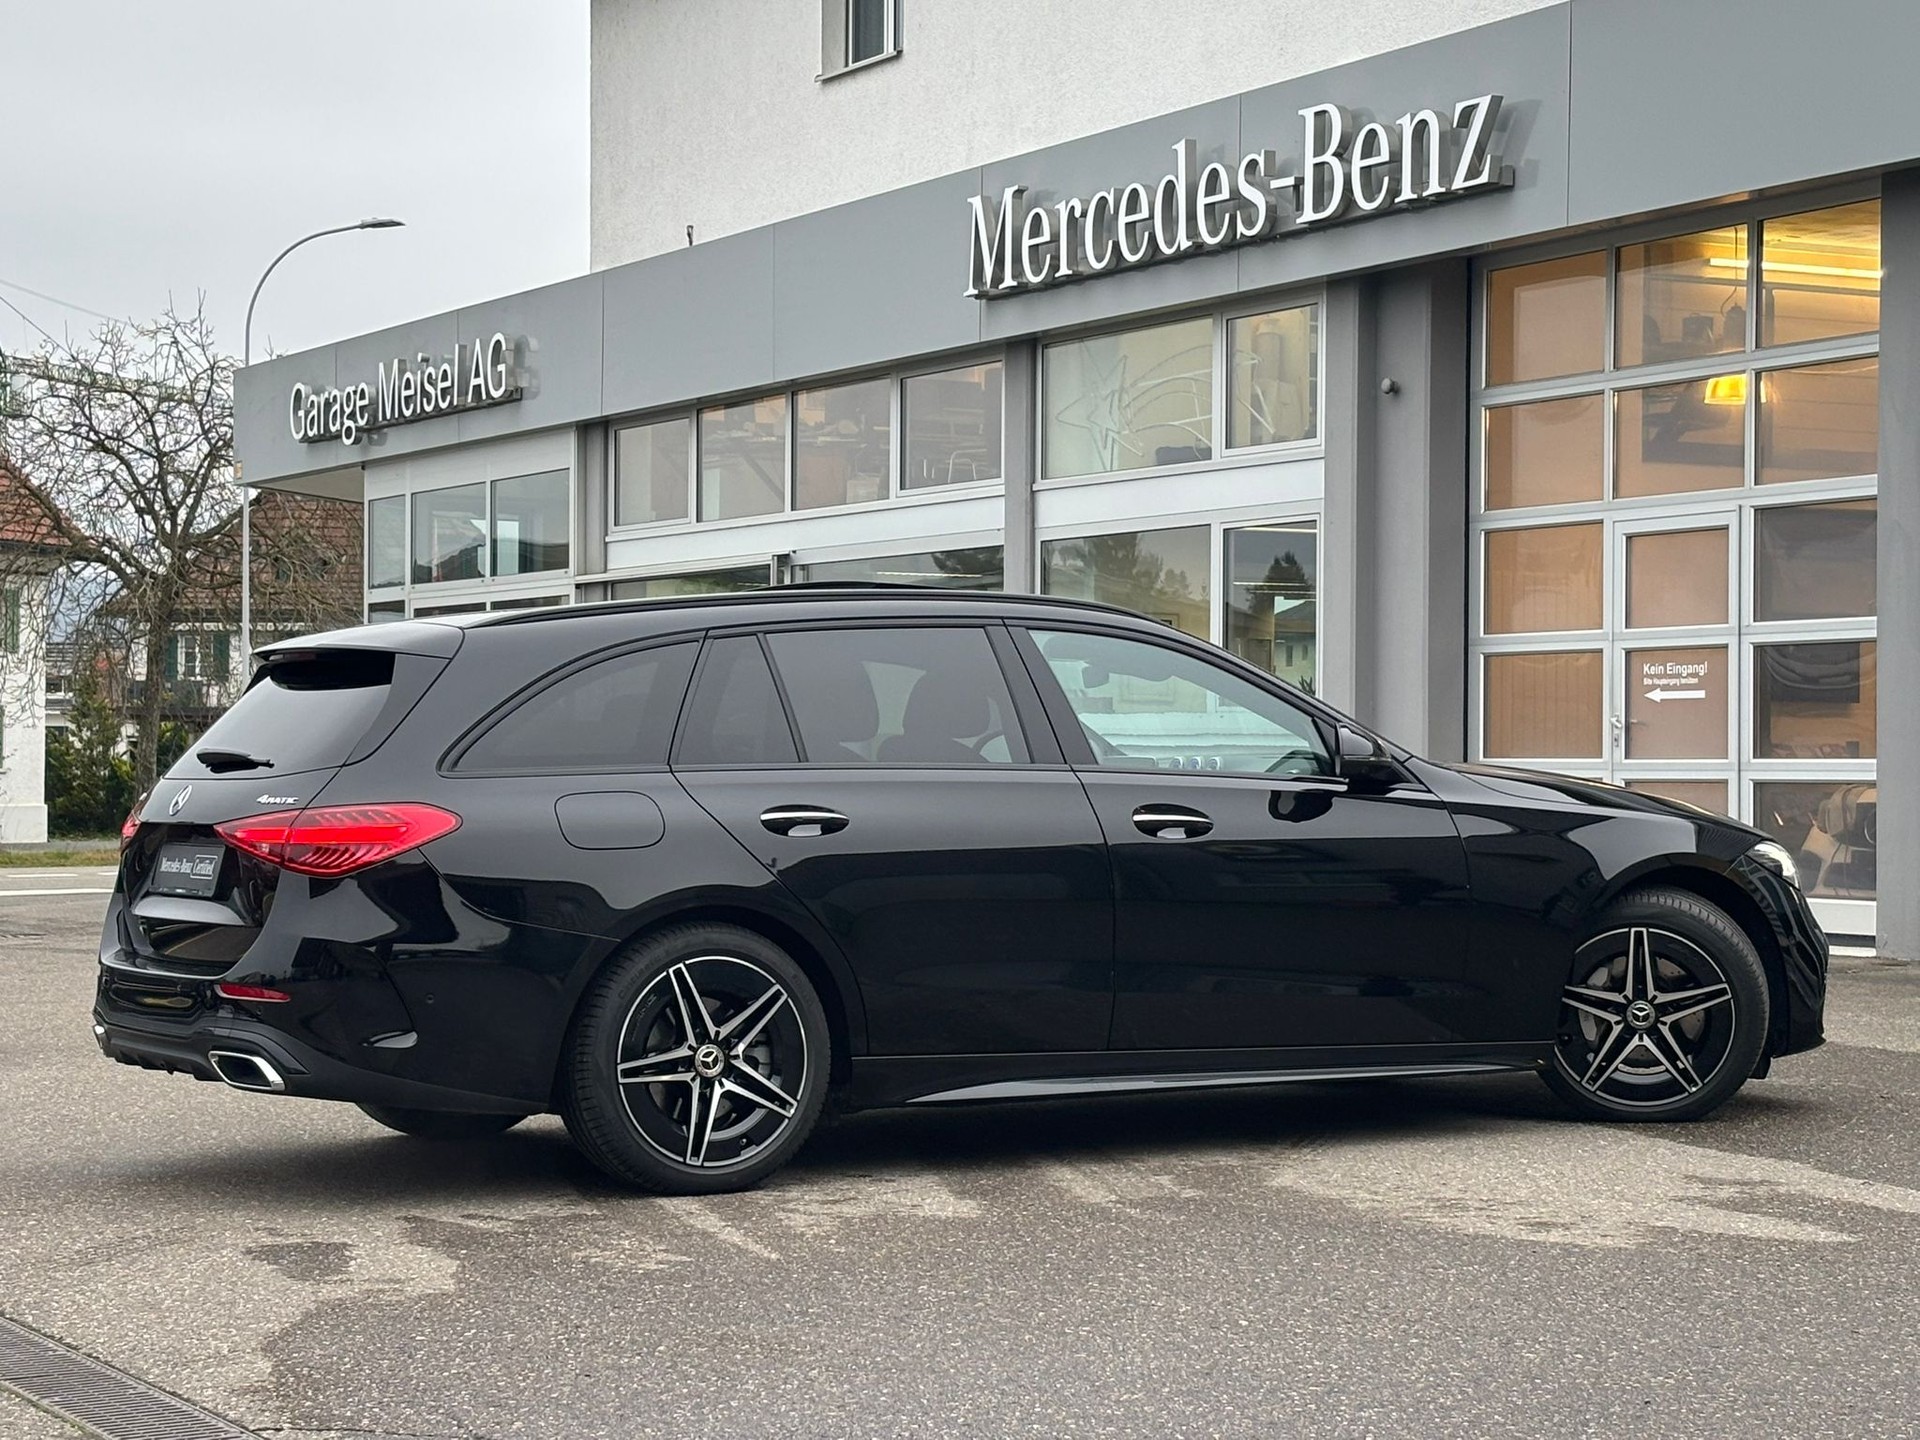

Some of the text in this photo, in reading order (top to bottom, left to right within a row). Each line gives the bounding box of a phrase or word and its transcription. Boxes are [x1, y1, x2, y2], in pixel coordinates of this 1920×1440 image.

[963, 94, 1504, 298] Mercedes-Benz
[290, 332, 507, 445] Garage Meisel AG
[1643, 661, 1708, 677] Kein Eingang!
[256, 794, 299, 804] 4MATIC
